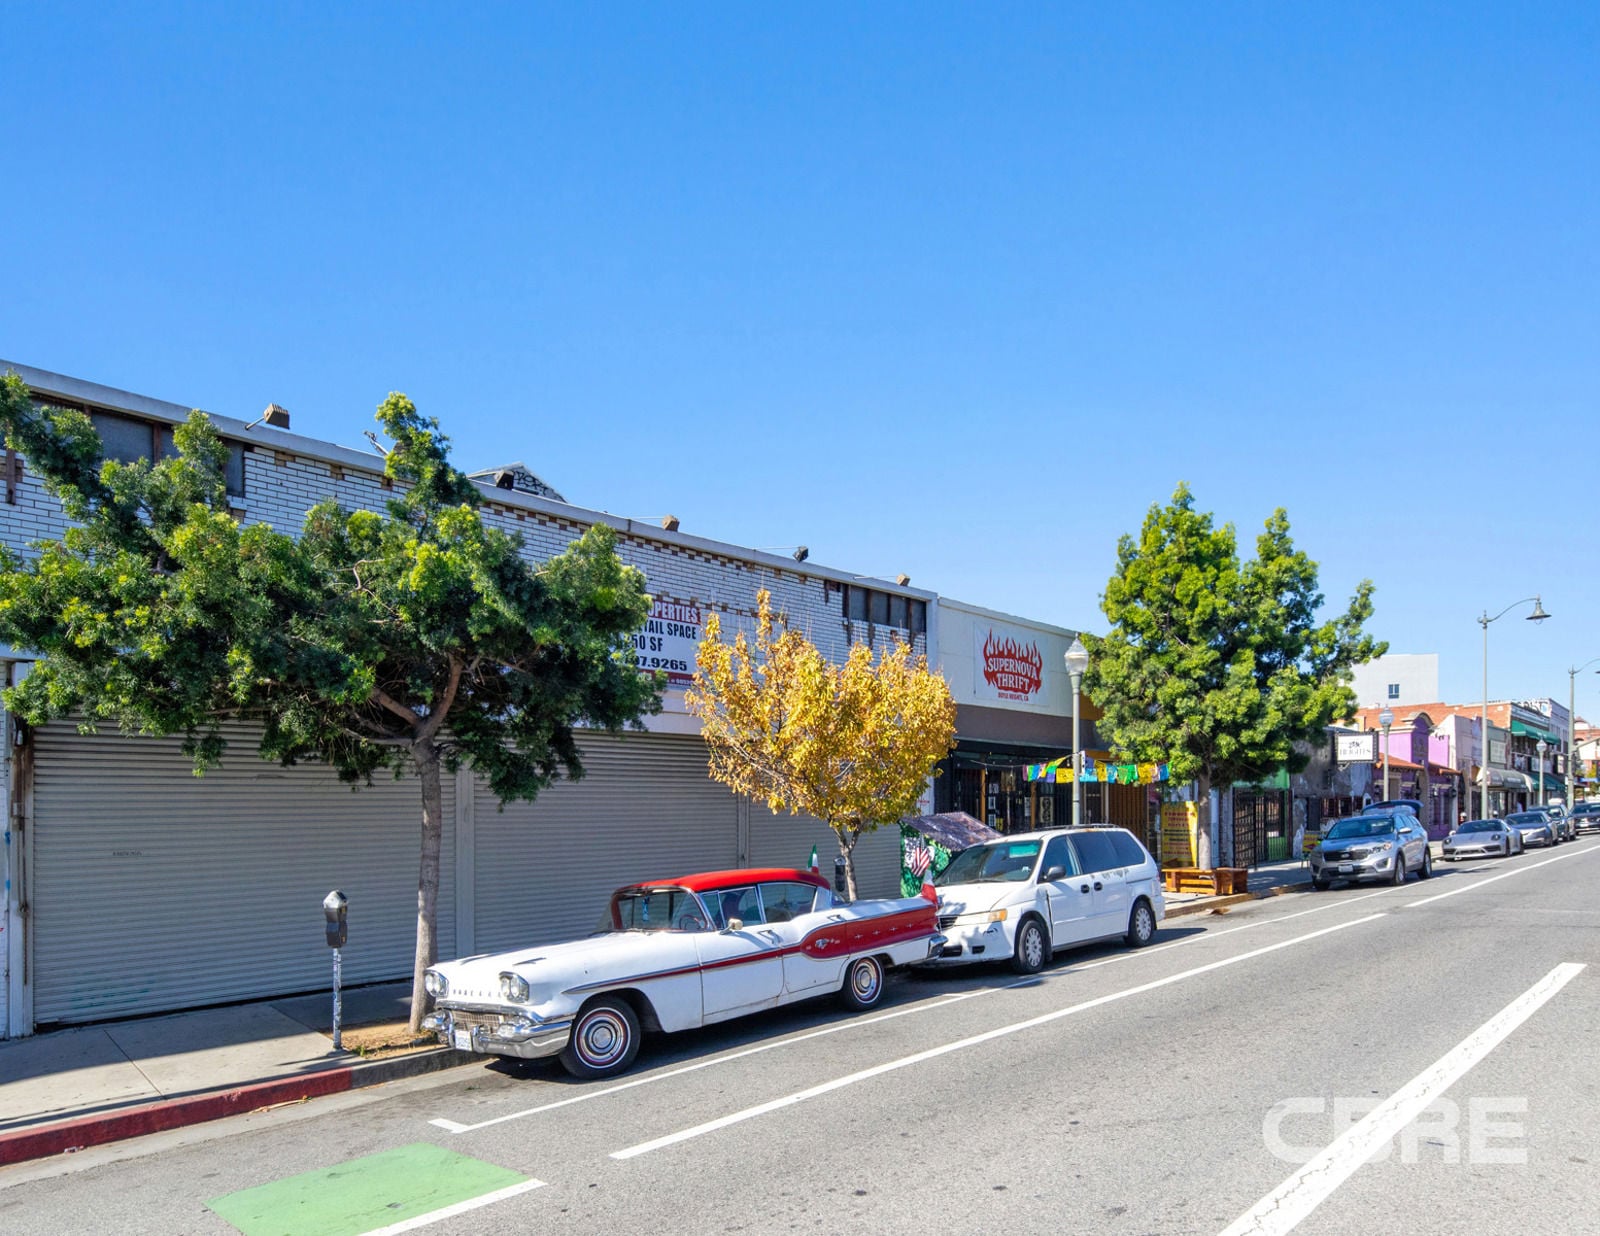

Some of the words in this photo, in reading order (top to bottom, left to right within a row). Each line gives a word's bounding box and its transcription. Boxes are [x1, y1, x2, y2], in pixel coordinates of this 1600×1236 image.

[648, 601, 697, 624] OPERTIES
[639, 619, 664, 635] TAIL
[667, 622, 697, 640] SPACE
[650, 636, 663, 652] SF
[987, 658, 1038, 680] SUPERNOVA
[996, 673, 1029, 691] THRIFT
